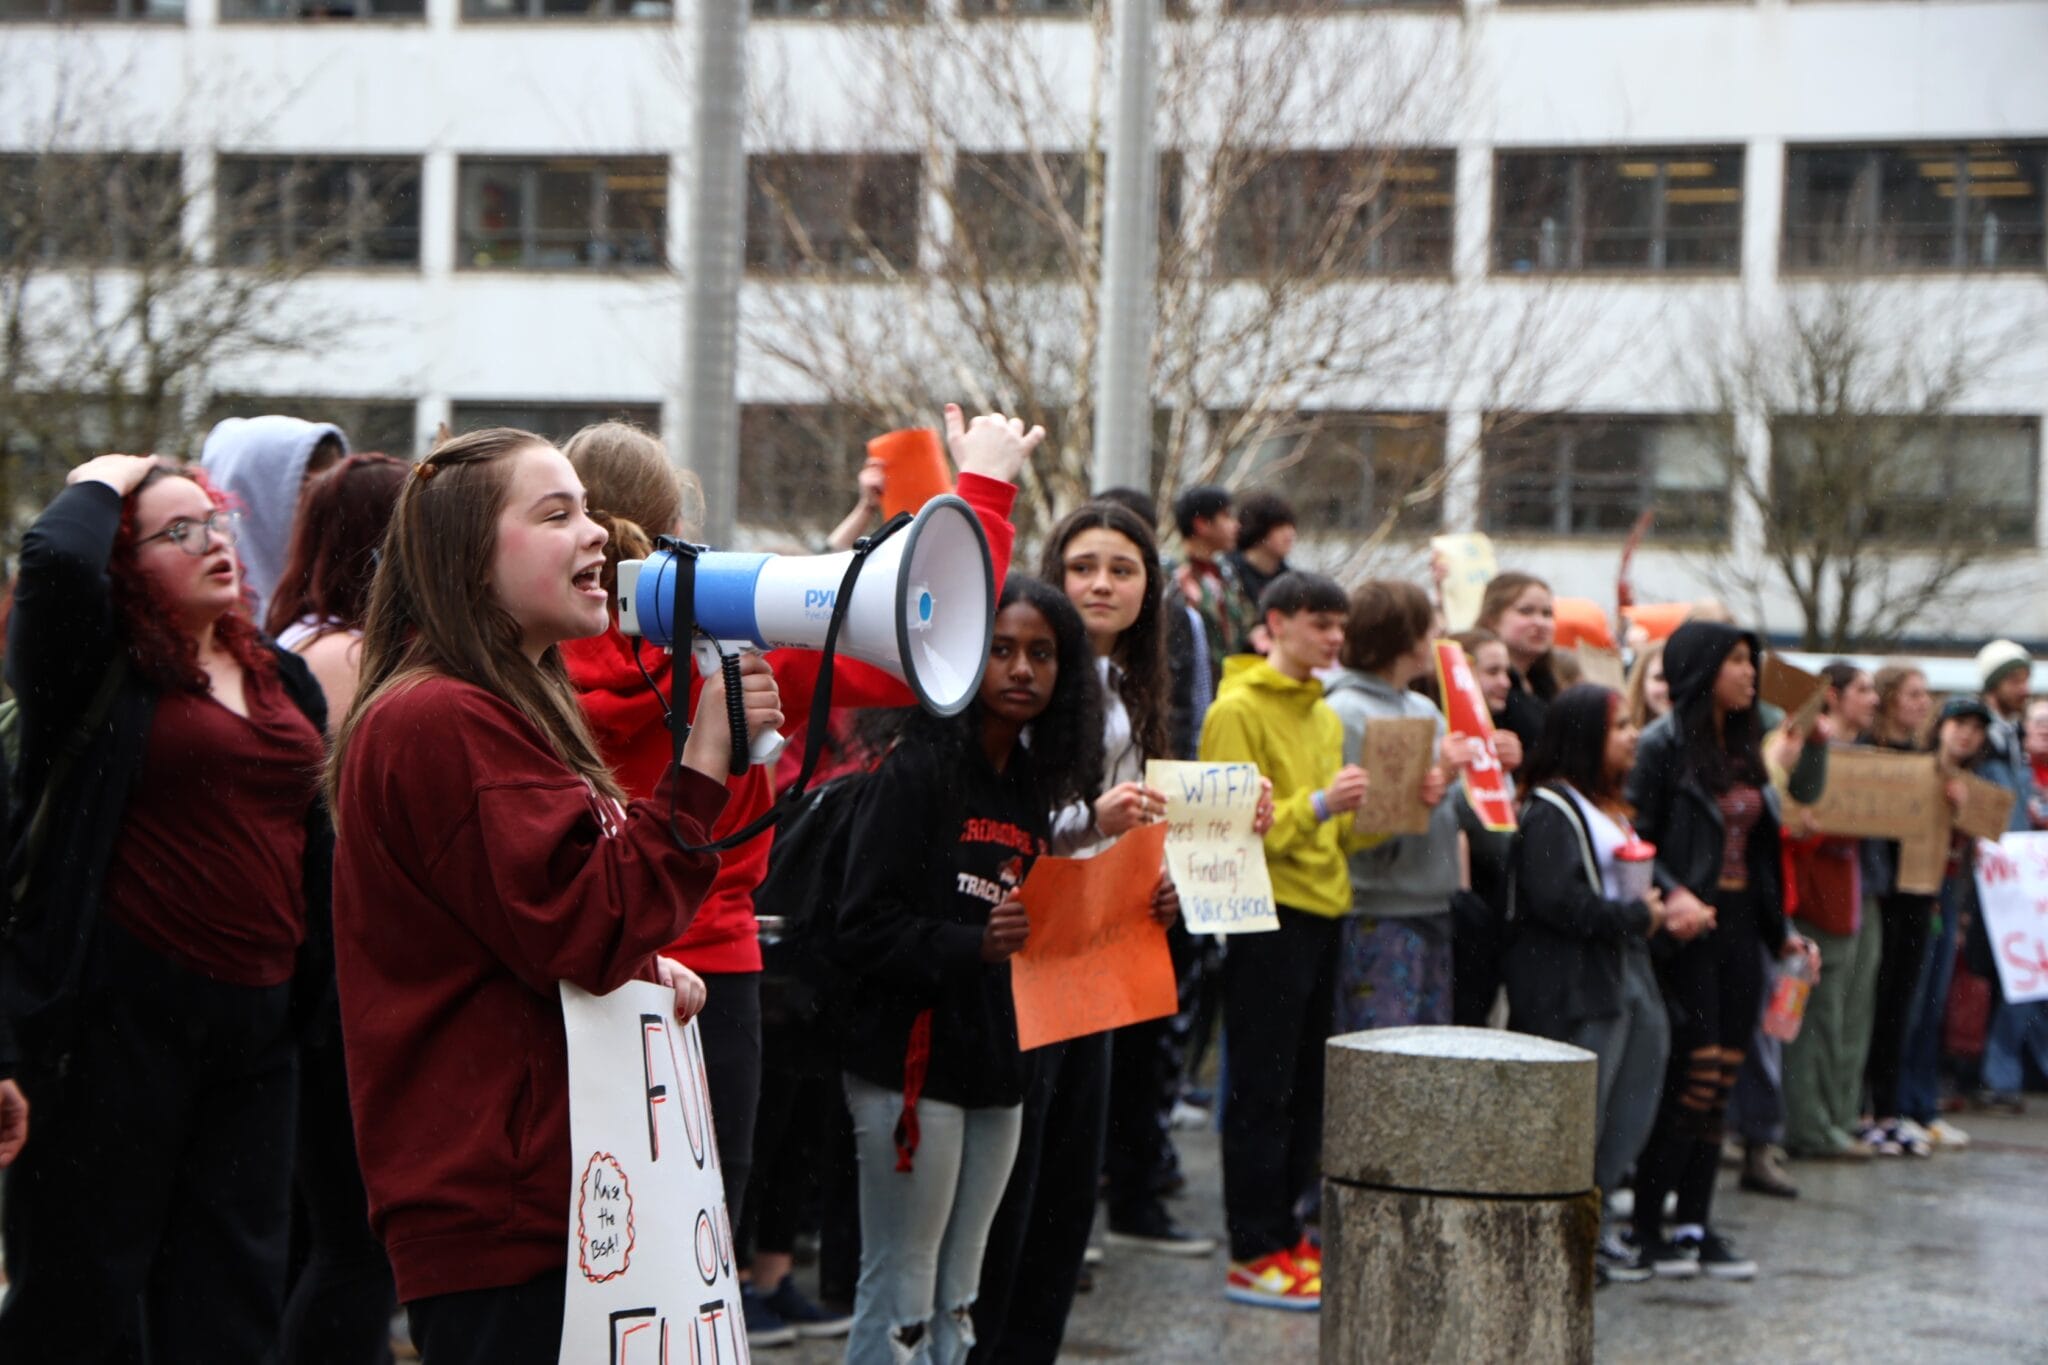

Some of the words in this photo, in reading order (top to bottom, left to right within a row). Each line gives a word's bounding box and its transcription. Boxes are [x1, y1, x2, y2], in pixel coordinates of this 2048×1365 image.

[805, 589, 837, 609] PYL
[1207, 820, 1233, 842] the
[593, 1168, 621, 1202] Raise
[597, 1207, 616, 1229] the
